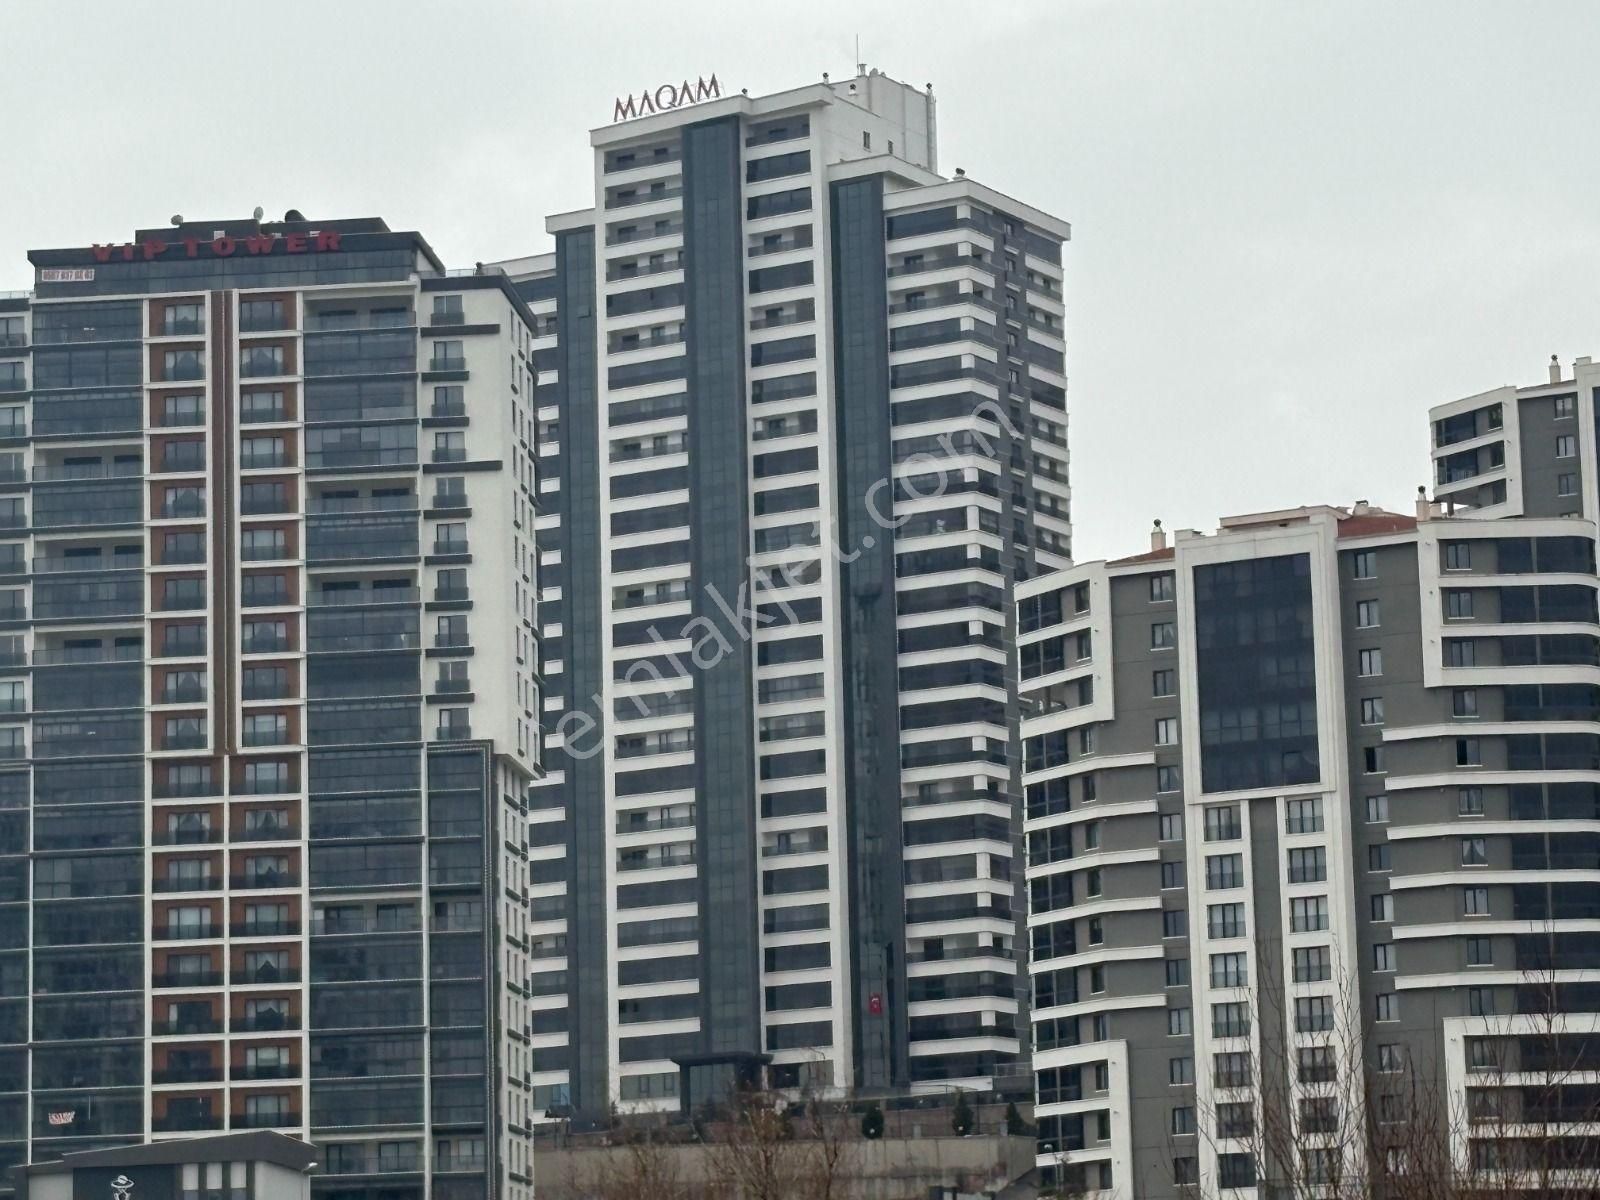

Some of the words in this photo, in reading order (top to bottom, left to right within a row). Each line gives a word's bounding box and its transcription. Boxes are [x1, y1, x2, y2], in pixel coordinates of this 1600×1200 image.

[614, 73, 720, 122] MAQAM
[92, 242, 166, 262] VIP
[183, 231, 342, 258] TOWER
